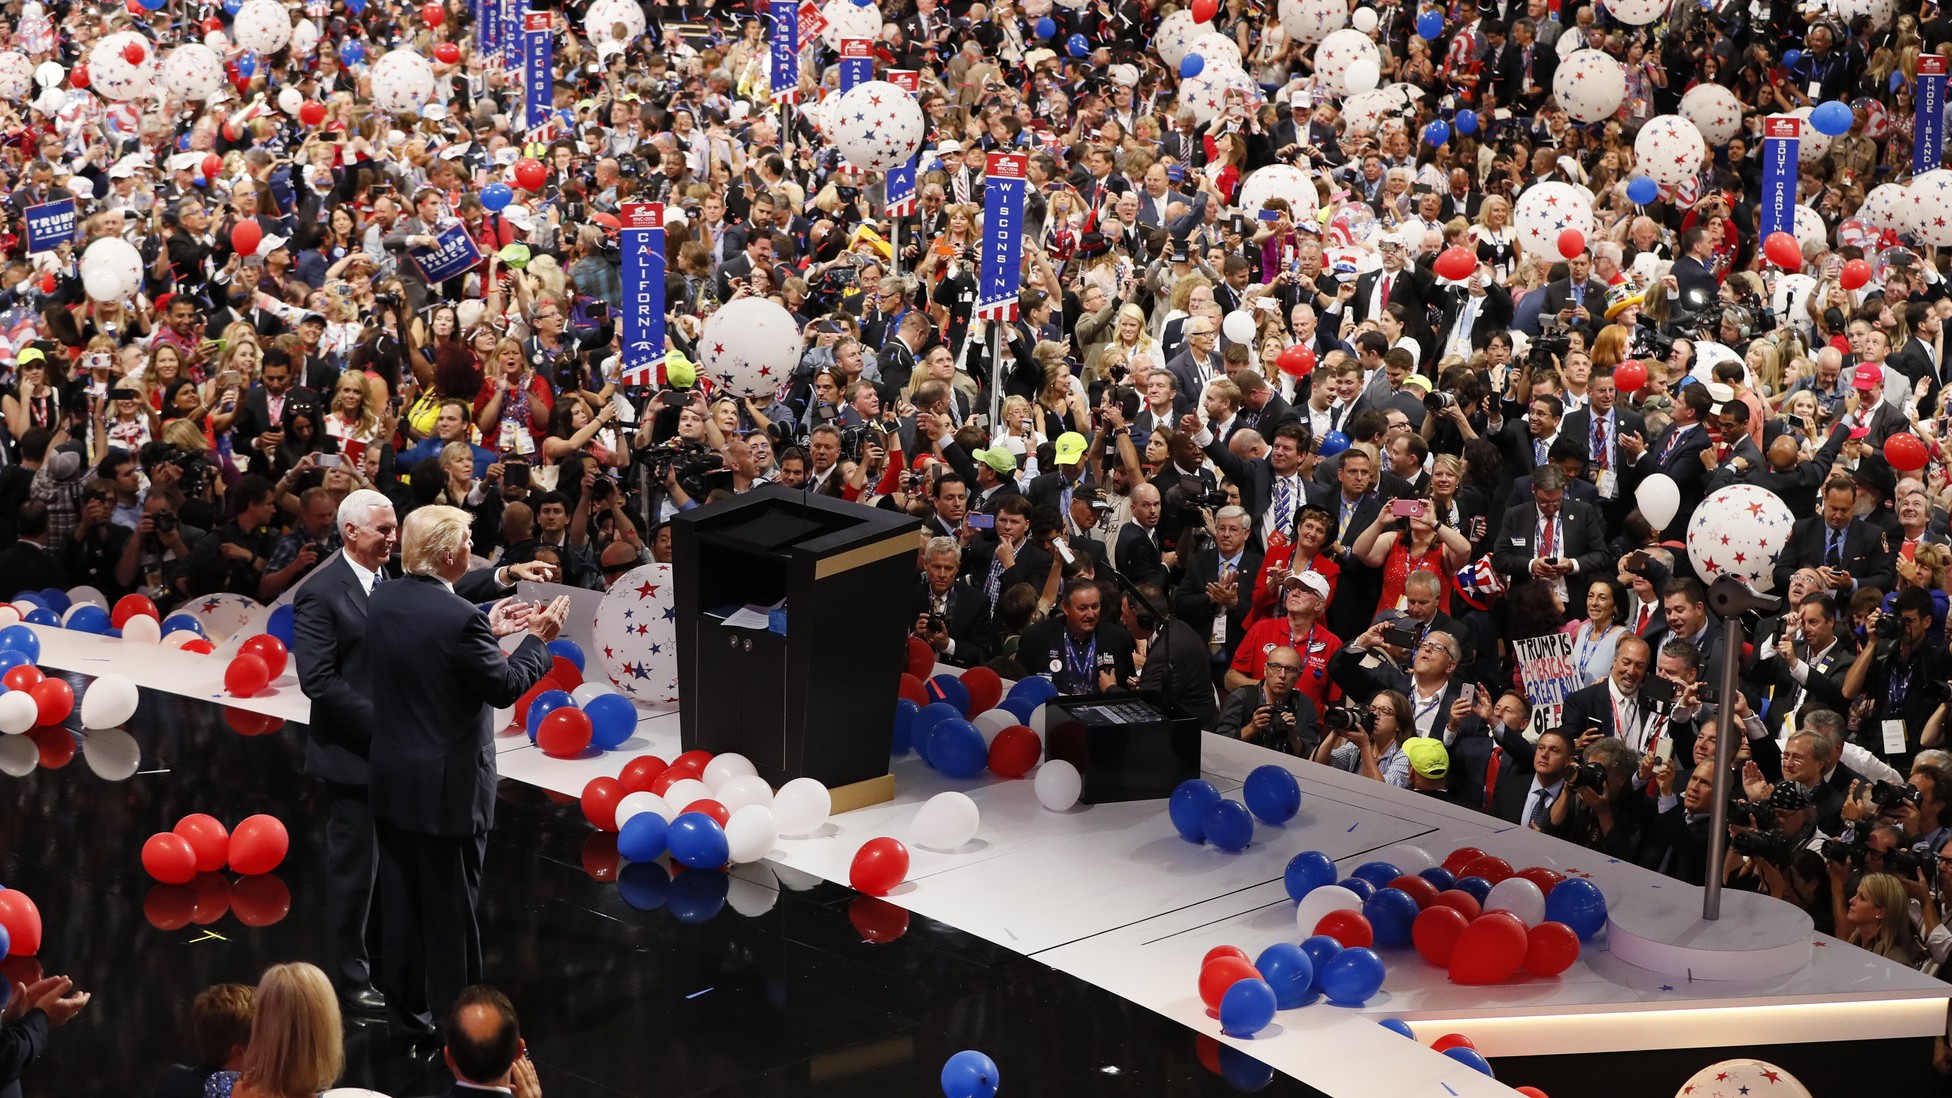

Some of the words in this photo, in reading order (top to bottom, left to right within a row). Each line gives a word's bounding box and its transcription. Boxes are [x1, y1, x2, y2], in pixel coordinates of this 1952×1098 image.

[779, 6, 790, 80] MSSOURI
[1926, 77, 1935, 113] RHODE
[1923, 119, 1933, 163] ISLAND
[1776, 140, 1786, 176] SOUTH
[29, 211, 75, 229] TRUMP
[1774, 182, 1784, 231] CAROLIN
[35, 222, 73, 236] PENCE
[995, 182, 1012, 287] WISCONSIN
[416, 235, 466, 265] TRUMP
[426, 246, 466, 269] PENCE
[637, 232, 650, 351] CALIFORNIA
[1517, 635, 1557, 661] TRUMP
[1558, 634, 1572, 656] IS
[1524, 655, 1573, 681] AMERICAS
[1527, 677, 1559, 706] GREAT
[1534, 706, 1550, 735] OF
